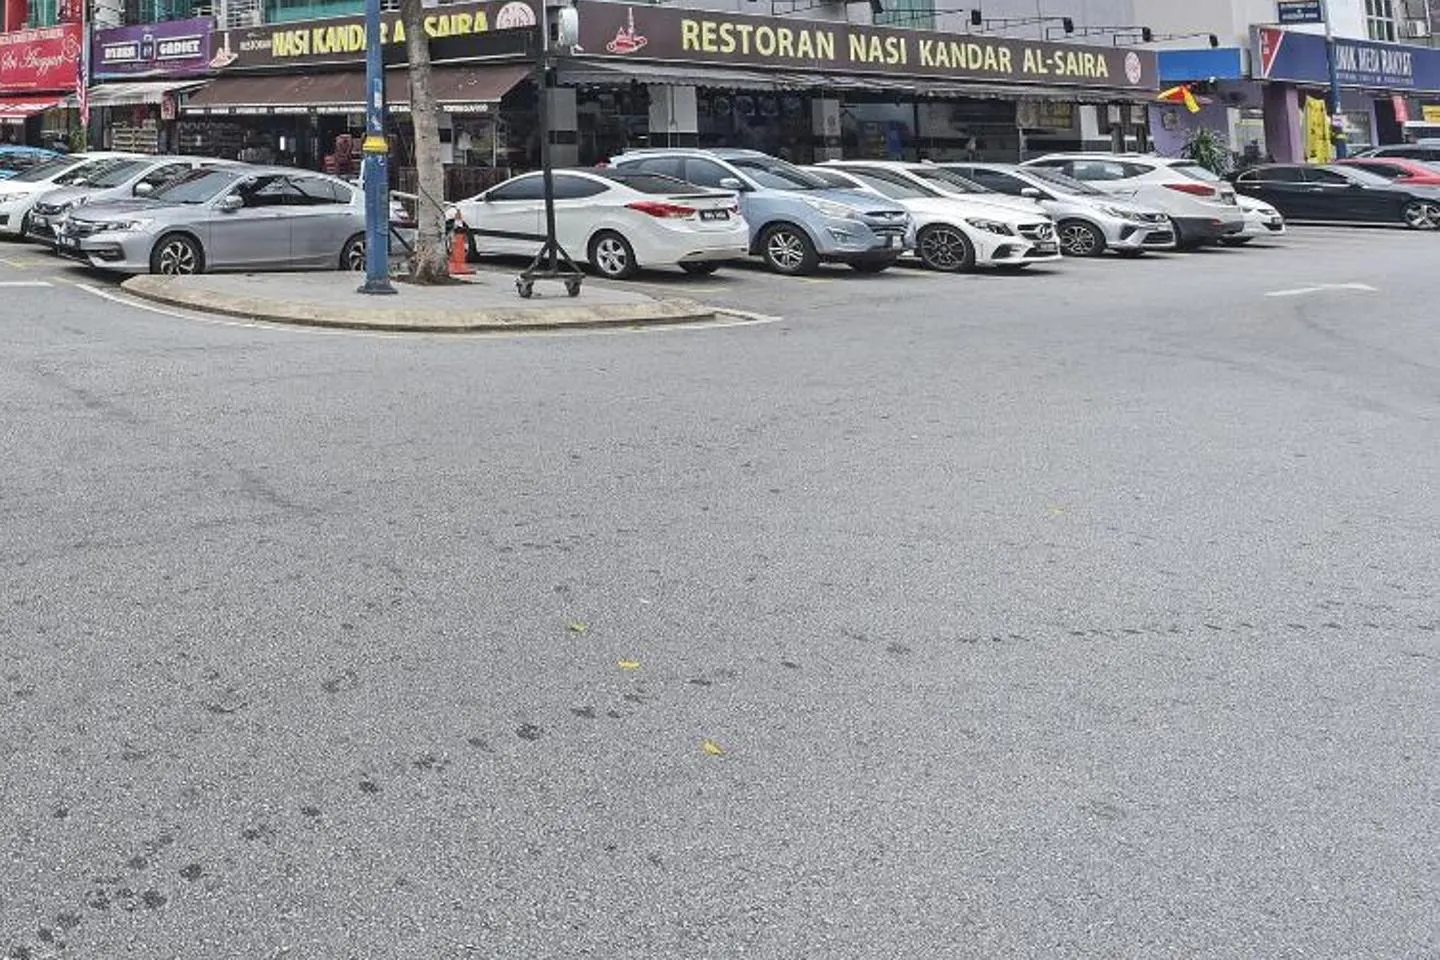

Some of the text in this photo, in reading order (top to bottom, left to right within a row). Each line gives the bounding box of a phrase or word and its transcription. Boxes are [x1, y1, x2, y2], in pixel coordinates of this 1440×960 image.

[272, 30, 310, 57] NASI
[681, 19, 1109, 78] RESTORAN NASI KANDAR AL-SAIRA
